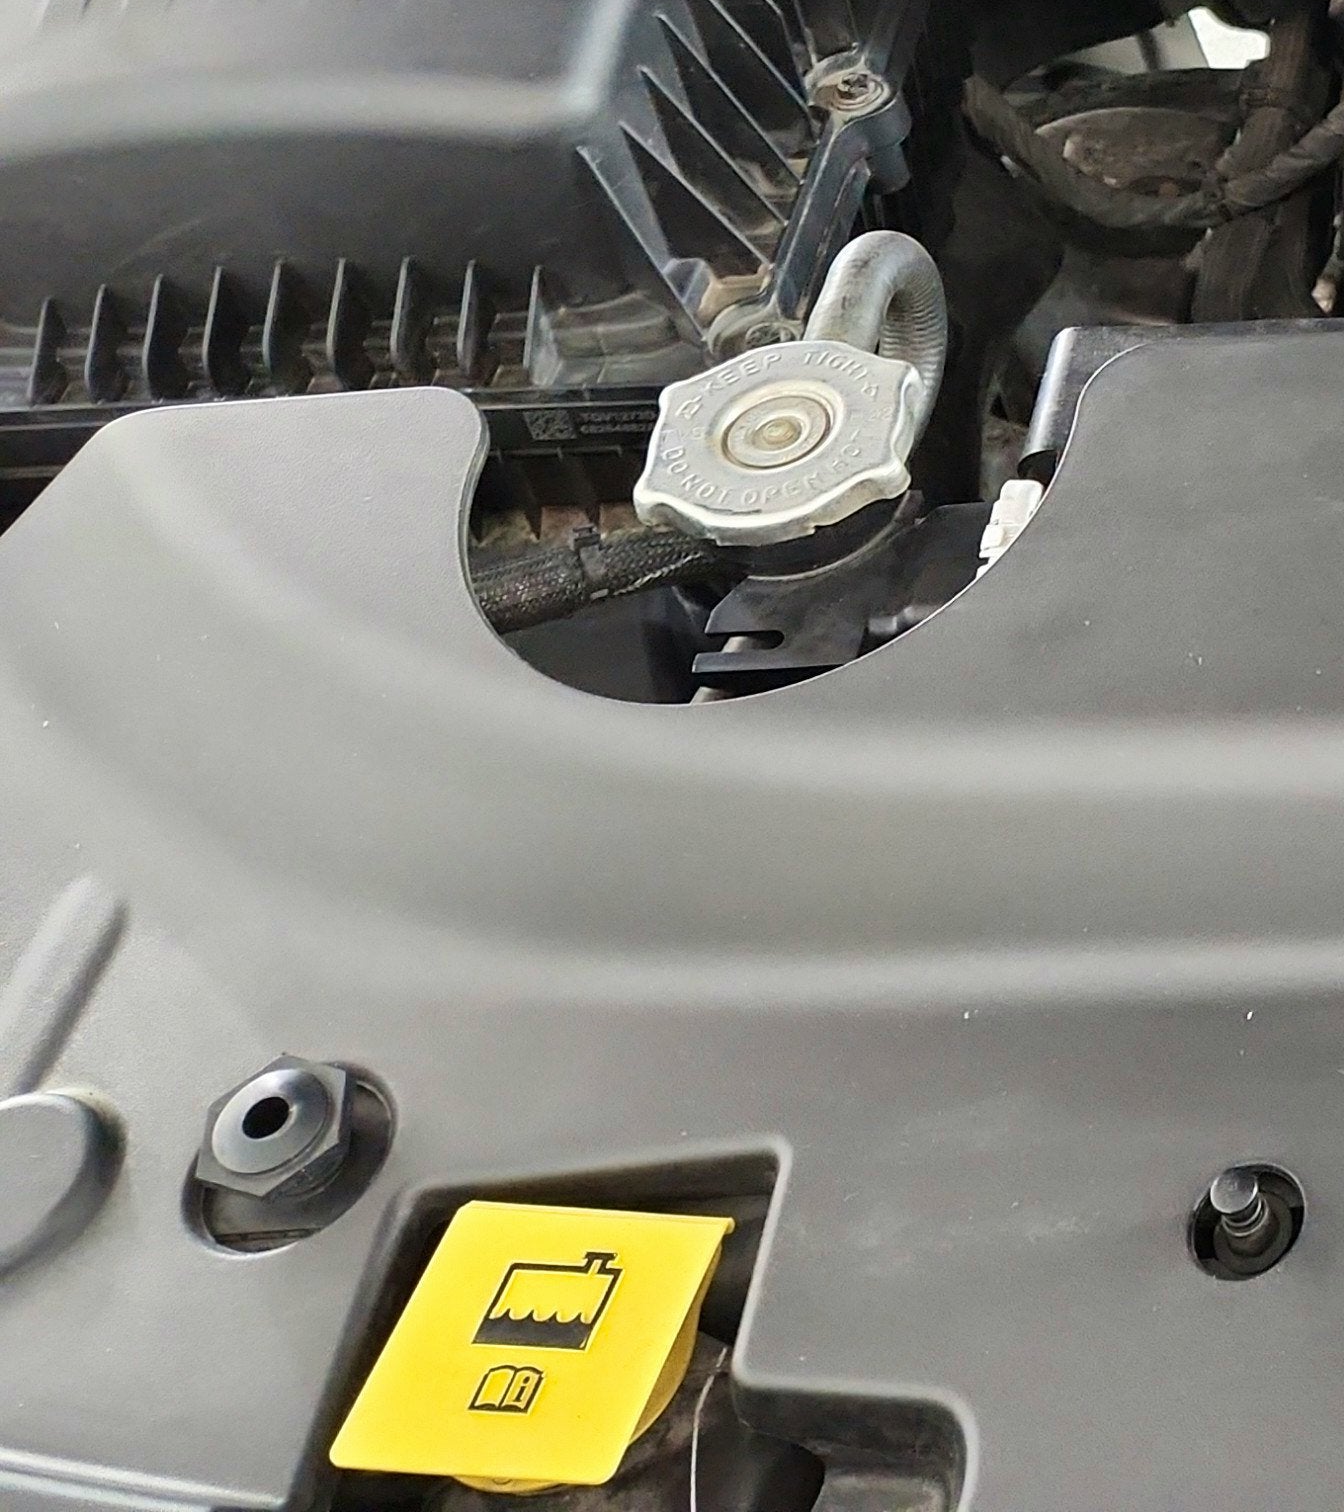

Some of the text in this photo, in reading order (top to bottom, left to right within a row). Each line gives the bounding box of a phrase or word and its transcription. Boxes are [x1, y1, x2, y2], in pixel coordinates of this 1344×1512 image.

[703, 351, 869, 395] KEEP TIGHT
[661, 444, 690, 476] DO
[681, 473, 731, 504] NOT
[740, 471, 820, 506] OPEN
